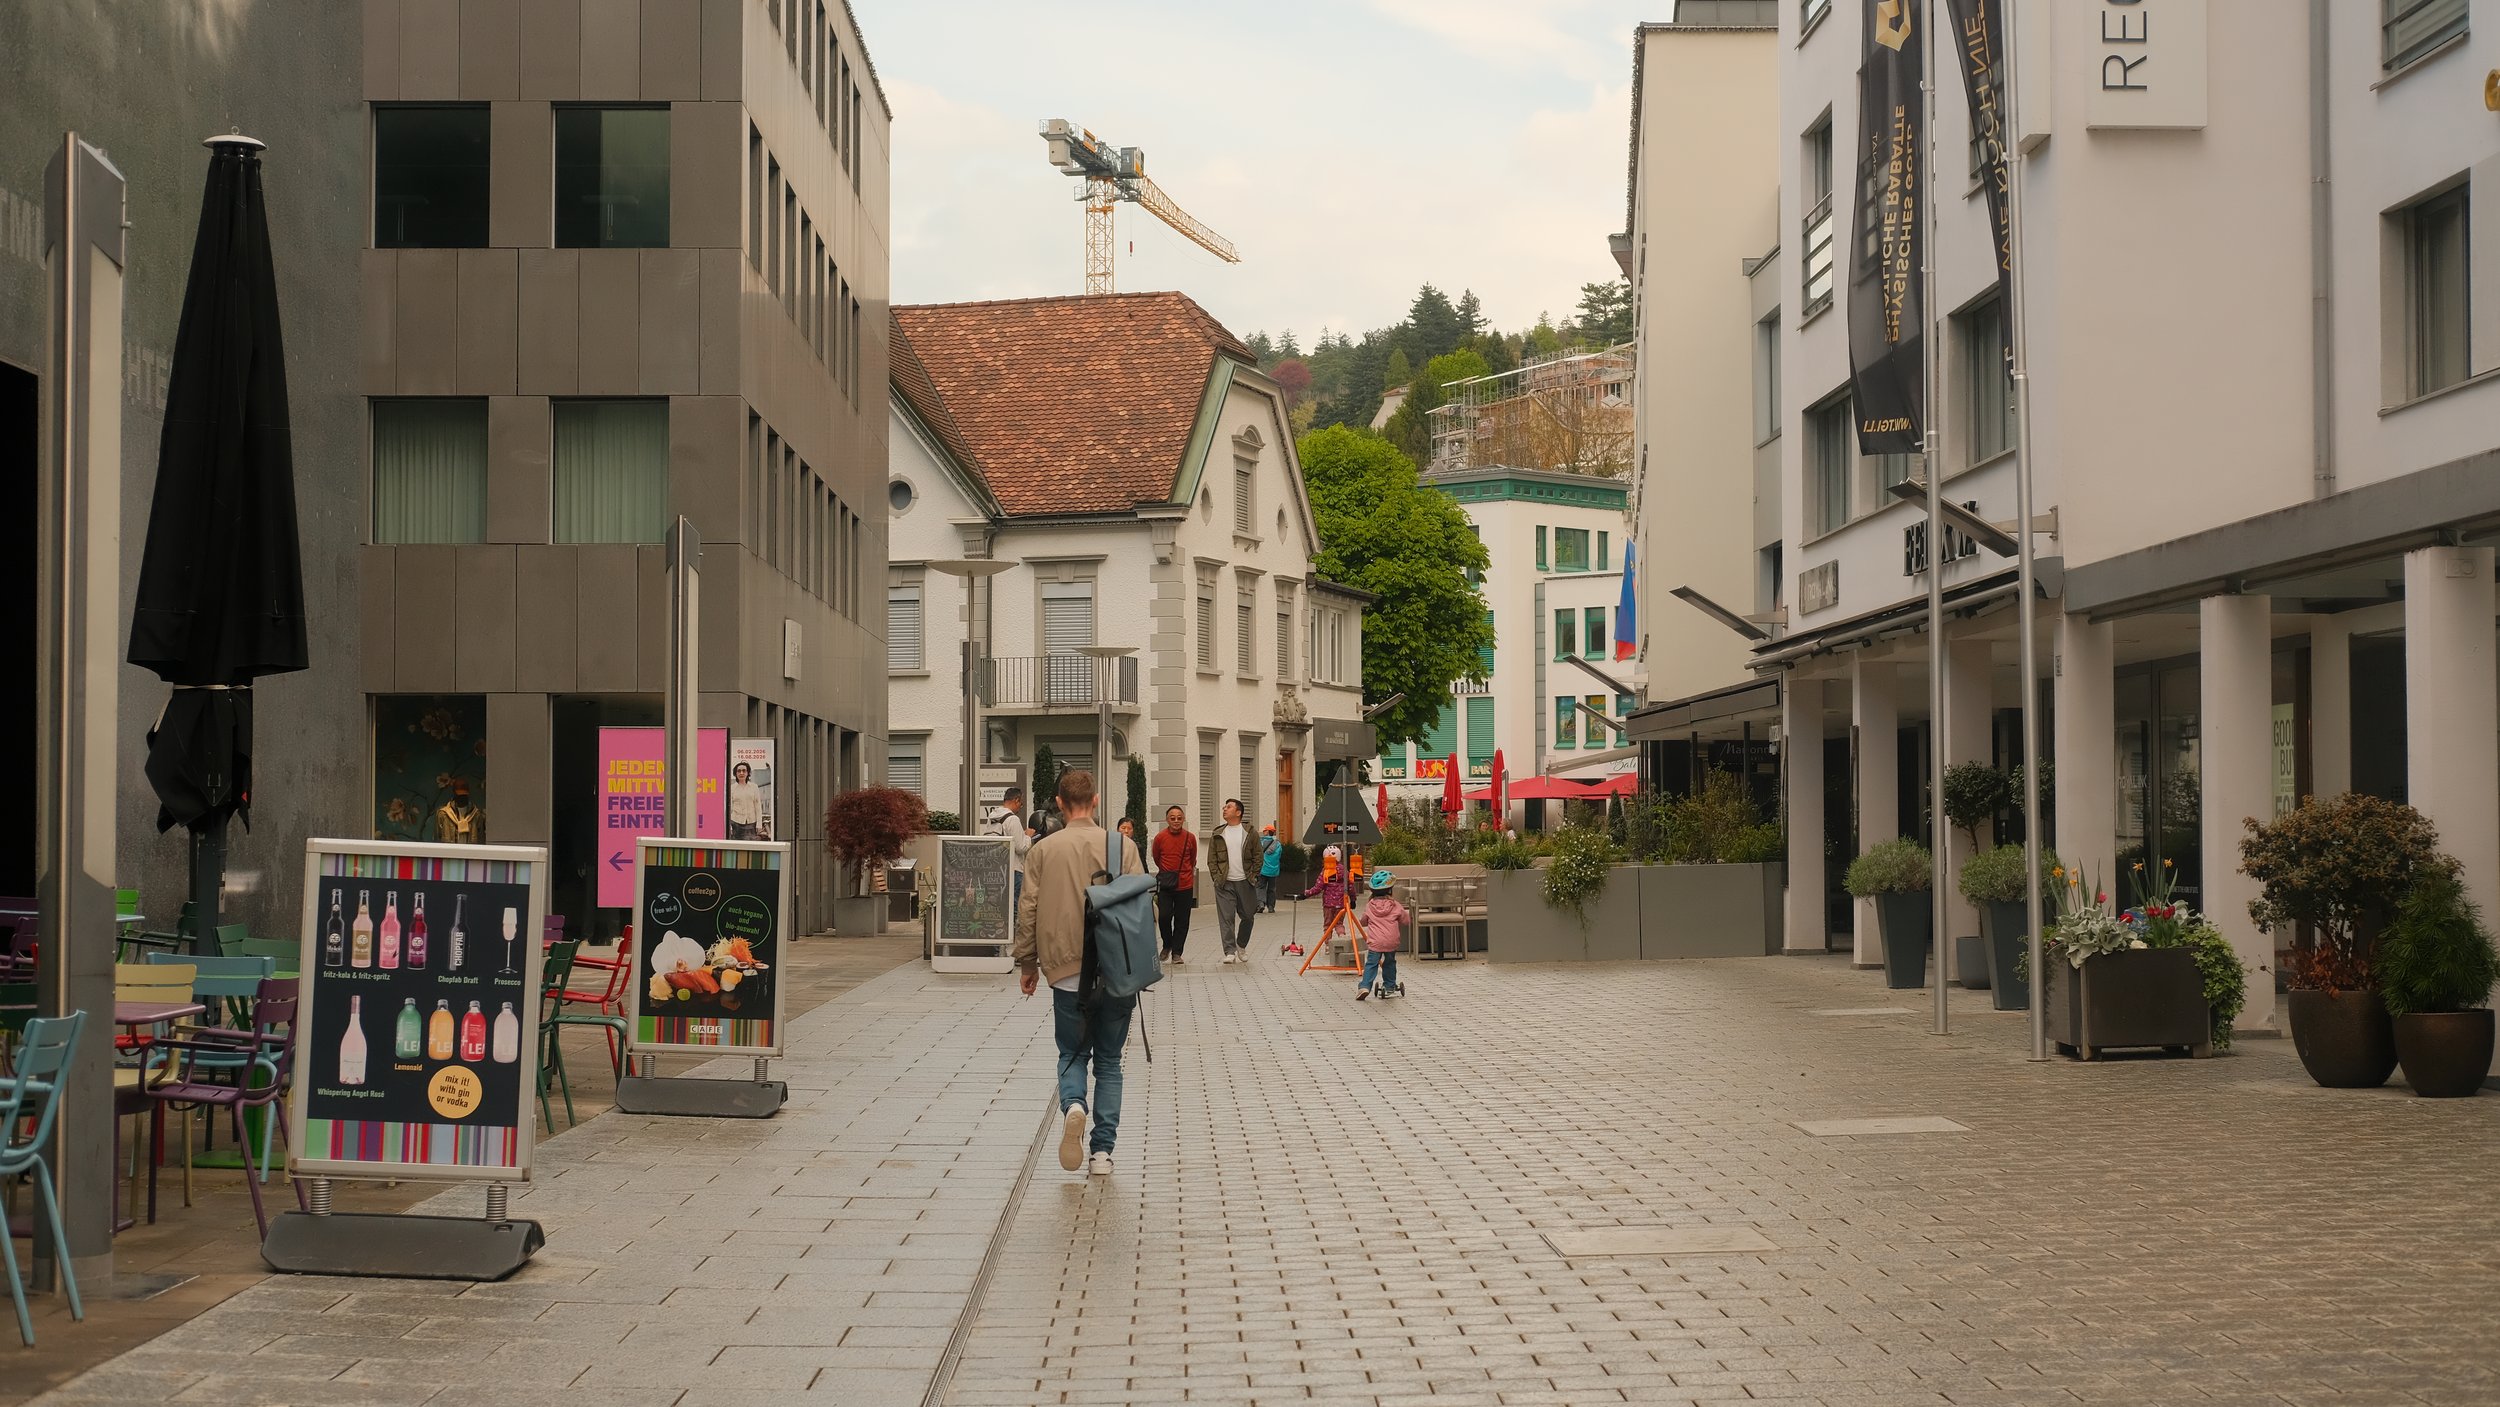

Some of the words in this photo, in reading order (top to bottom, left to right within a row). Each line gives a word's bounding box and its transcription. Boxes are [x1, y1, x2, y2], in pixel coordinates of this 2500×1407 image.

[2102, 0, 2148, 91] RE
[1471, 765, 1491, 774] BAR
[688, 887, 716, 896] coffee2go
[728, 906, 742, 915] auch
[744, 908, 763, 919] vegane
[455, 931, 464, 966] CHOPFAB
[323, 971, 351, 980] fritz-kola
[358, 972, 391, 981] fritz-spritz
[438, 975, 462, 984] Chopfab
[463, 976, 479, 984] Draft
[494, 977, 521, 986] Prosecco
[394, 1063, 422, 1071] Lemonaid
[445, 1075, 458, 1084] mix
[461, 1076, 470, 1086] it!
[318, 1088, 351, 1098] Whispering
[352, 1088, 368, 1098] Angel
[439, 1084, 456, 1095] with
[458, 1088, 470, 1098] gin
[436, 1095, 445, 1103] or
[446, 1095, 468, 1108] vodka
